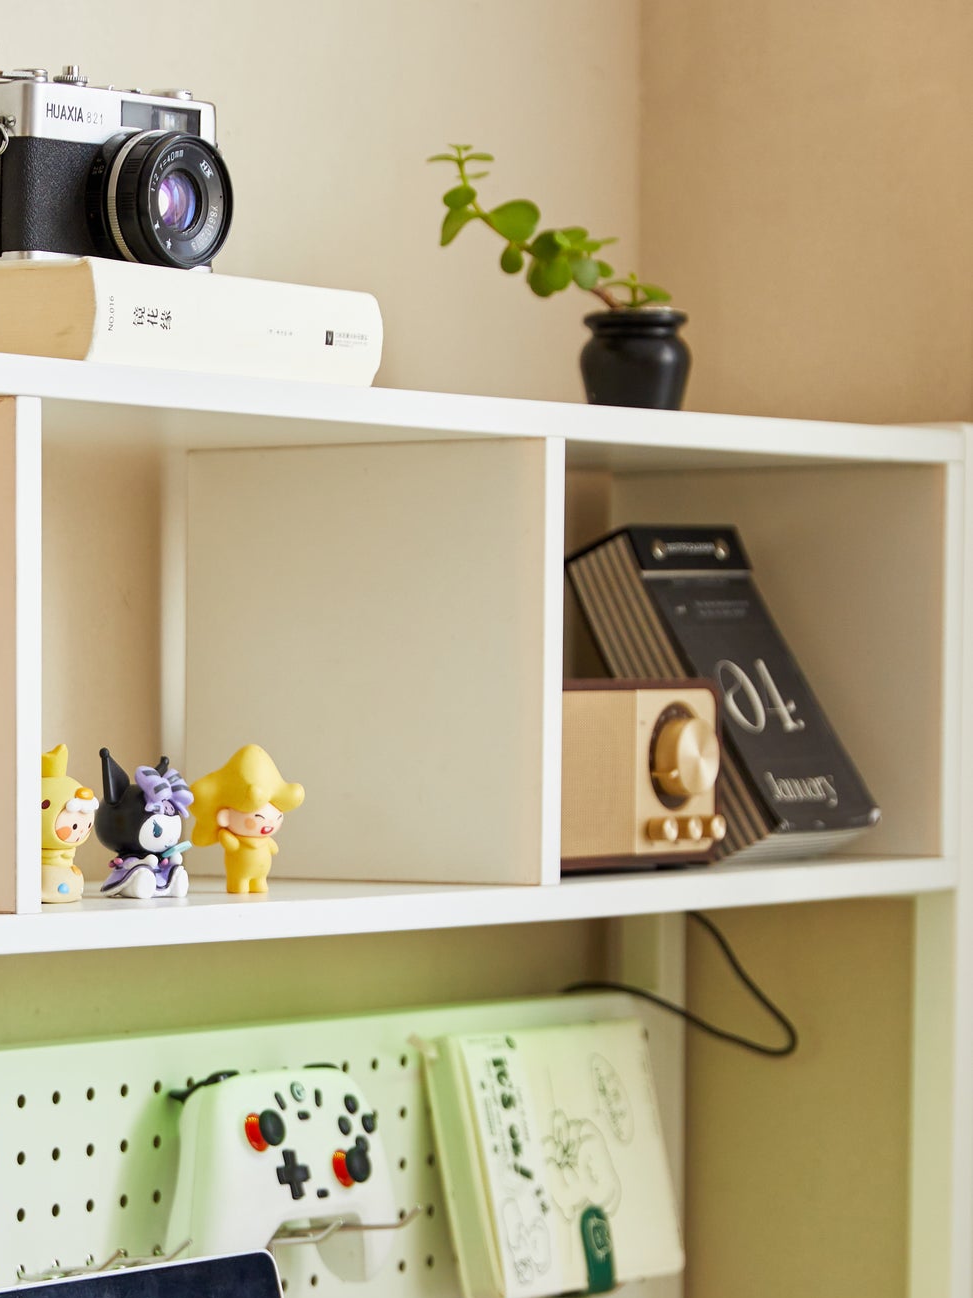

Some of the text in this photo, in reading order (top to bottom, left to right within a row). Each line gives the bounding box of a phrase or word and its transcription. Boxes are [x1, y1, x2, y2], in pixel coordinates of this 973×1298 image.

[46, 102, 103, 125] HUAXIA 821
[715, 659, 805, 733] 04
